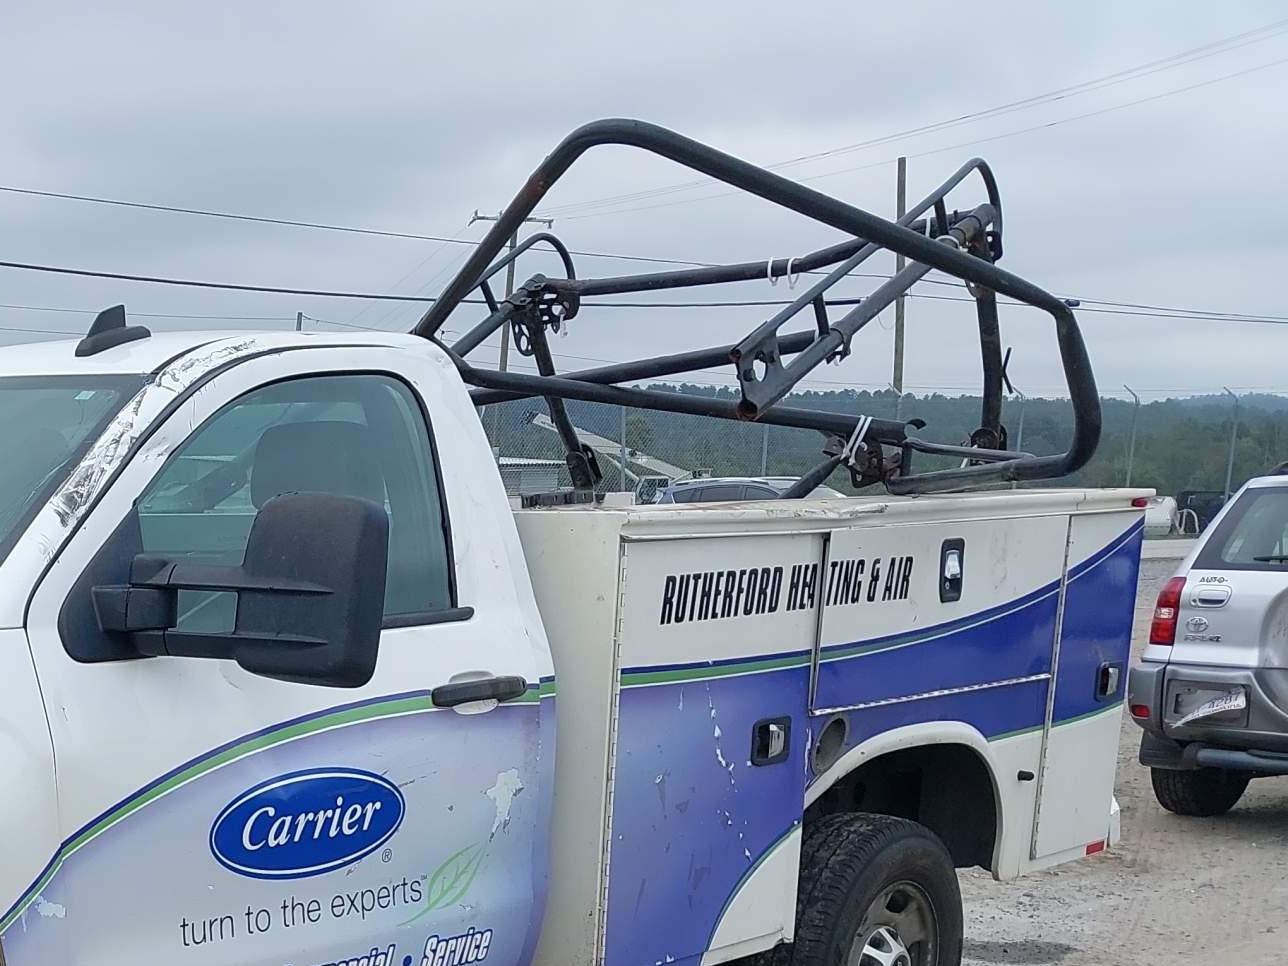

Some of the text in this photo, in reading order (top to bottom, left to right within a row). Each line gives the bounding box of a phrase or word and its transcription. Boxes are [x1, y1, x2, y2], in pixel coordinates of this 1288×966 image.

[660, 556, 914, 626] RUTHERFORD HEATING & AIR
[241, 796, 382, 851] Carrier
[179, 877, 423, 947] turn to the experts
